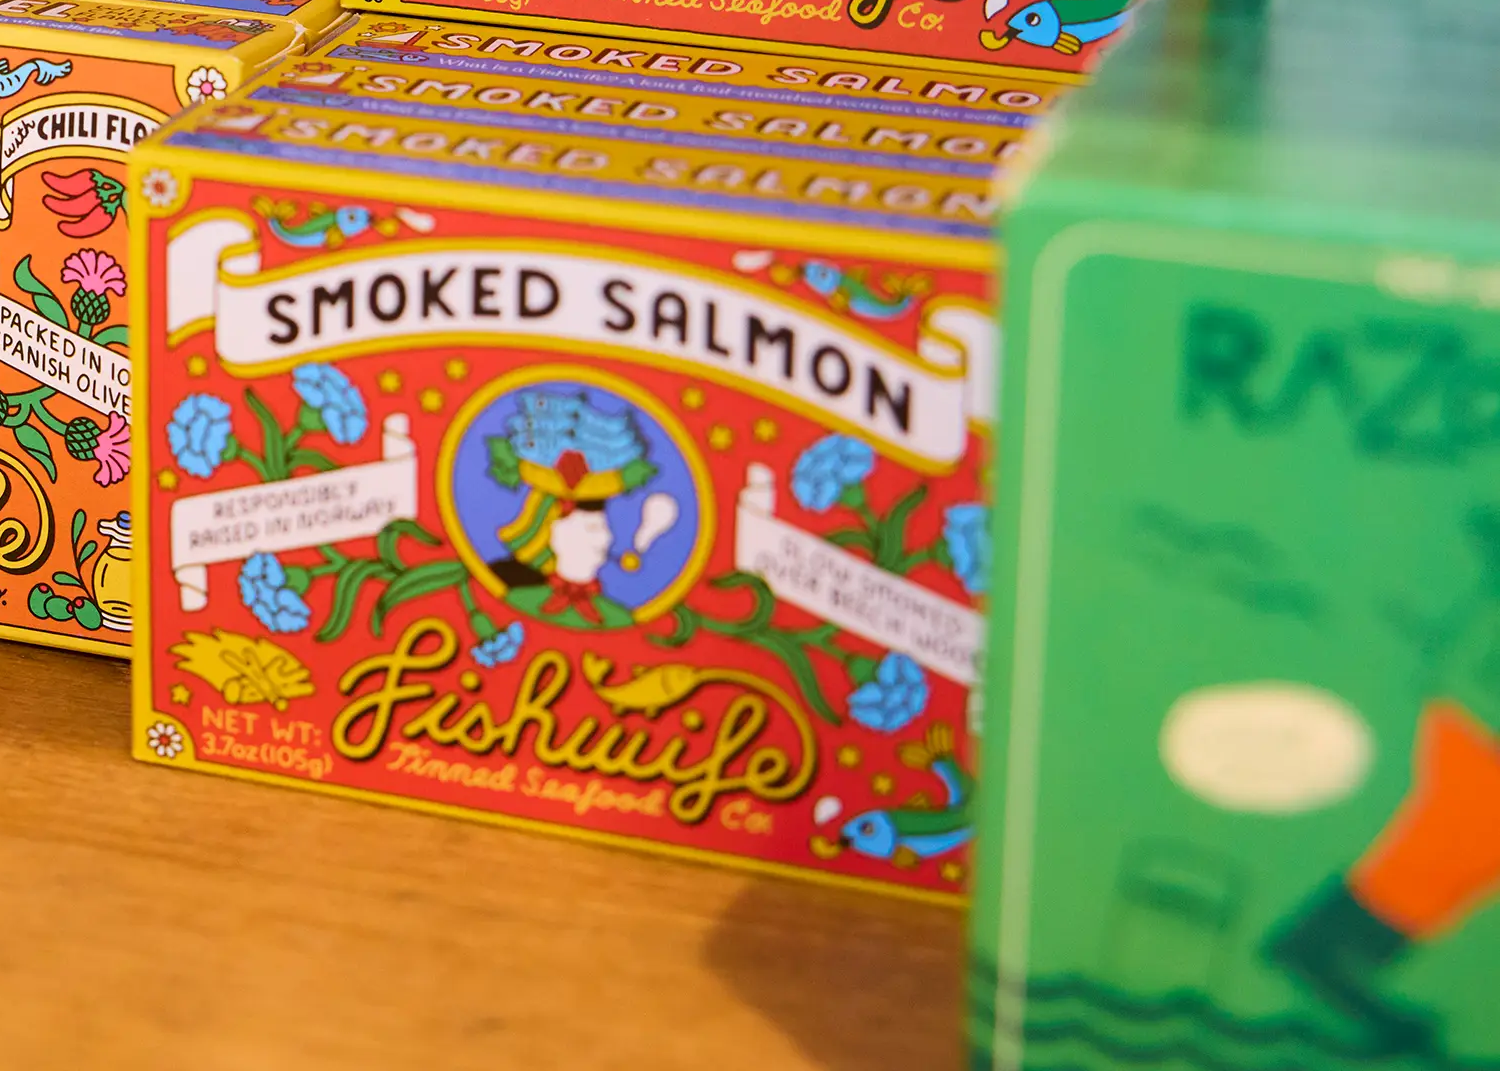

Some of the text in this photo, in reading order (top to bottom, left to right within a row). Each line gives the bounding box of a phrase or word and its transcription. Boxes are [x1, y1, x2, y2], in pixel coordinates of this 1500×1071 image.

[898, 2, 945, 32] Co.
[435, 32, 743, 77] SMOKED
[5, 112, 156, 158] with CHILI FLA
[0, 307, 131, 386] PACKED IN 10
[267, 266, 914, 434] SMOKED SALMON
[77, 374, 131, 414] OLIVE
[333, 618, 819, 822] Fishwife
